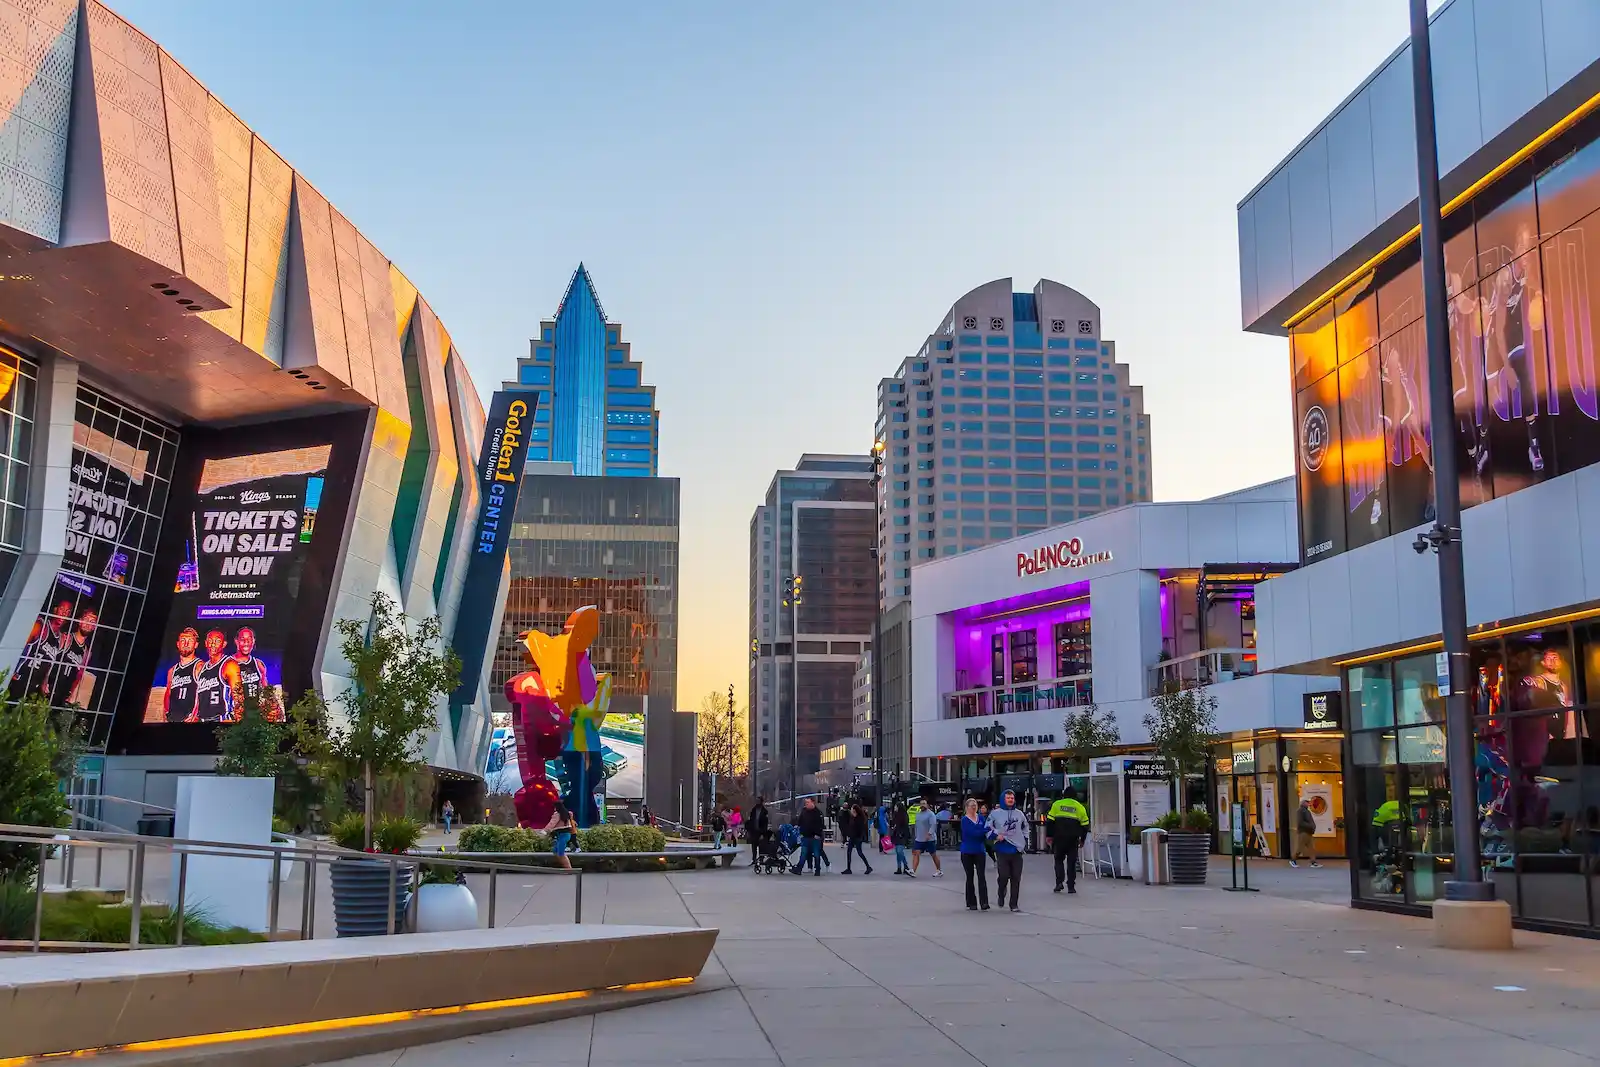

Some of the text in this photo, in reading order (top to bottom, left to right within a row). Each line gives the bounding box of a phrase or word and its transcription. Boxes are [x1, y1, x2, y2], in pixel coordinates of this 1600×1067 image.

[494, 399, 528, 483] Golden 1
[1308, 427, 1321, 449] 40
[484, 427, 503, 480] Credit Union
[240, 489, 271, 505] Kings
[203, 509, 298, 530] TICKETS
[478, 483, 505, 554] CENTER
[202, 532, 296, 554] ON SALE
[220, 556, 275, 576] NOW
[1070, 550, 1114, 568] CANTINA
[209, 591, 257, 599] ticketmaster
[178, 687, 187, 700] 11
[210, 690, 219, 705] 5
[965, 720, 1055, 748] TOM'S WATCH BAR
